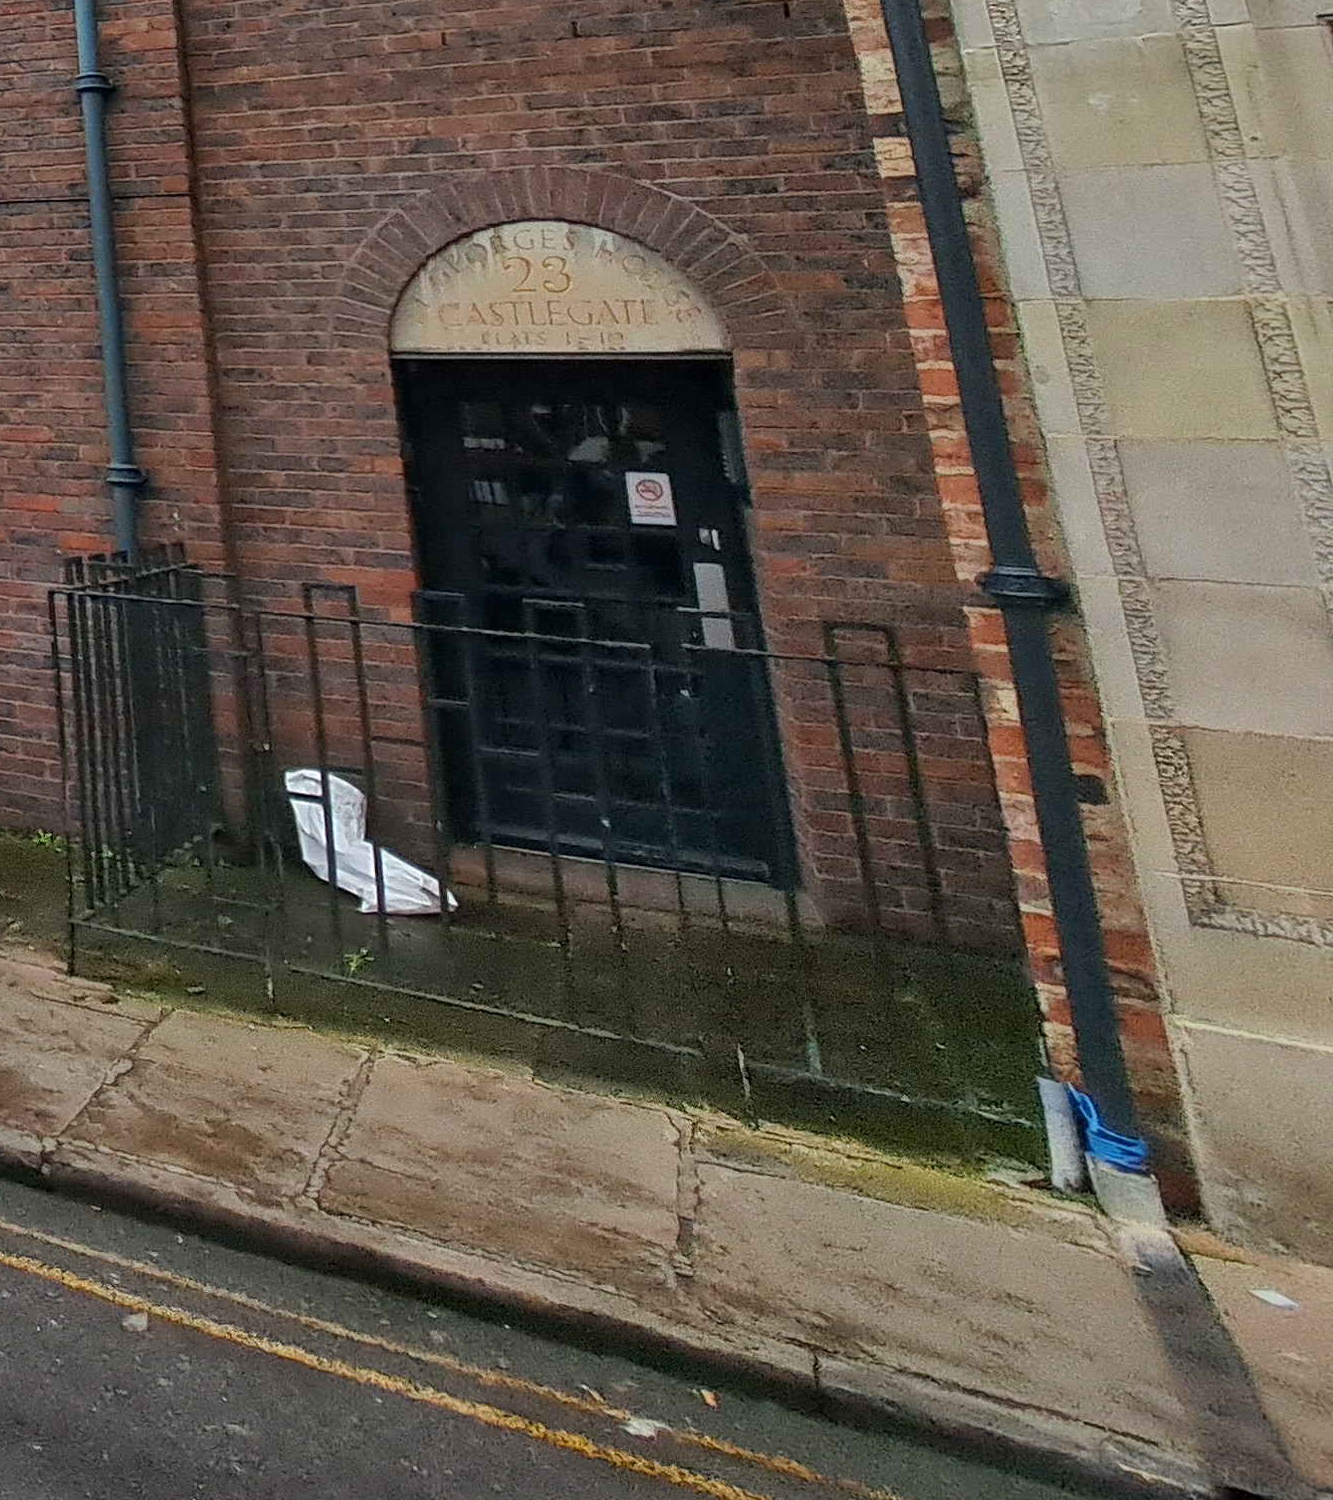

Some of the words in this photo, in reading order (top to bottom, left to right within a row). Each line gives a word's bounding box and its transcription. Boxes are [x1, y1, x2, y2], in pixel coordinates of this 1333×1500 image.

[502, 255, 572, 294] 23
[437, 298, 660, 327] CASTLEGATE
[482, 330, 547, 346] FLATS
